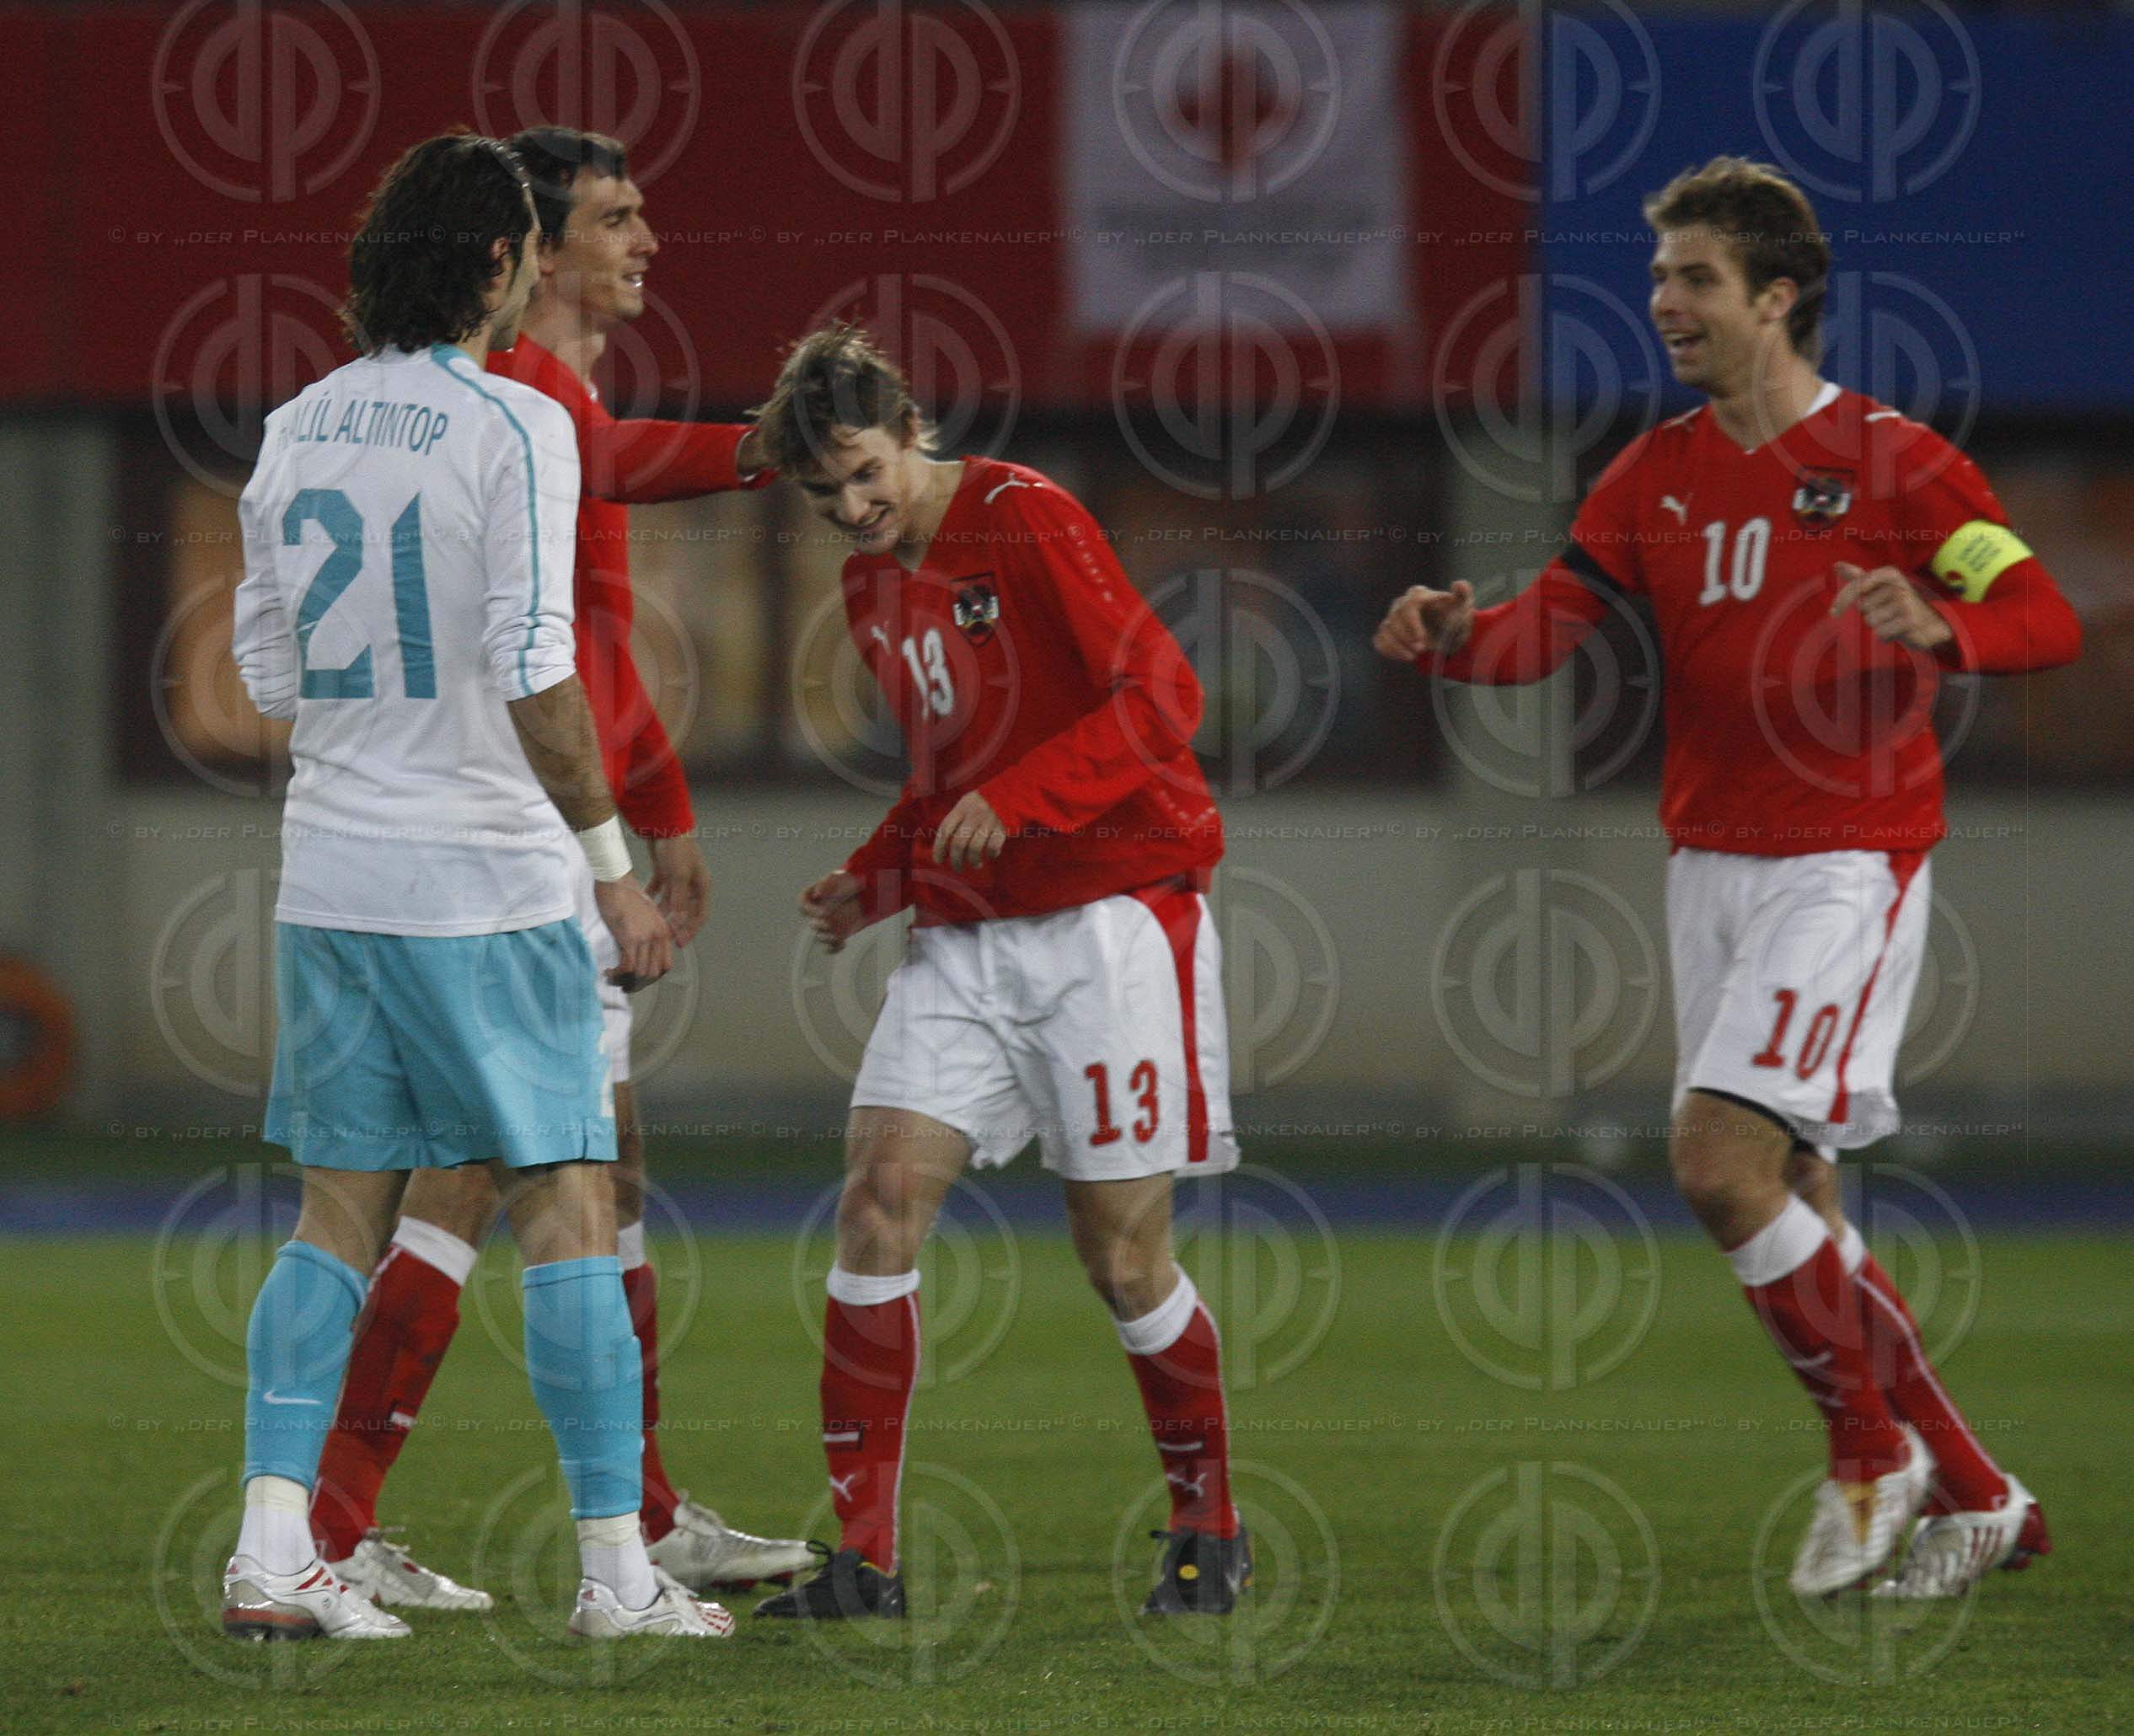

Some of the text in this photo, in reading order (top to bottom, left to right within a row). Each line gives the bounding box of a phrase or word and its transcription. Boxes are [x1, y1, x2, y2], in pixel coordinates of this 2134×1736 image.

[333, 399, 449, 456] ALTINTOP
[281, 488, 437, 699] 21
[1699, 517, 1771, 605] 10
[901, 627, 955, 721] 13
[1751, 989, 1840, 1080] 10
[1084, 1059, 1160, 1146] 13
